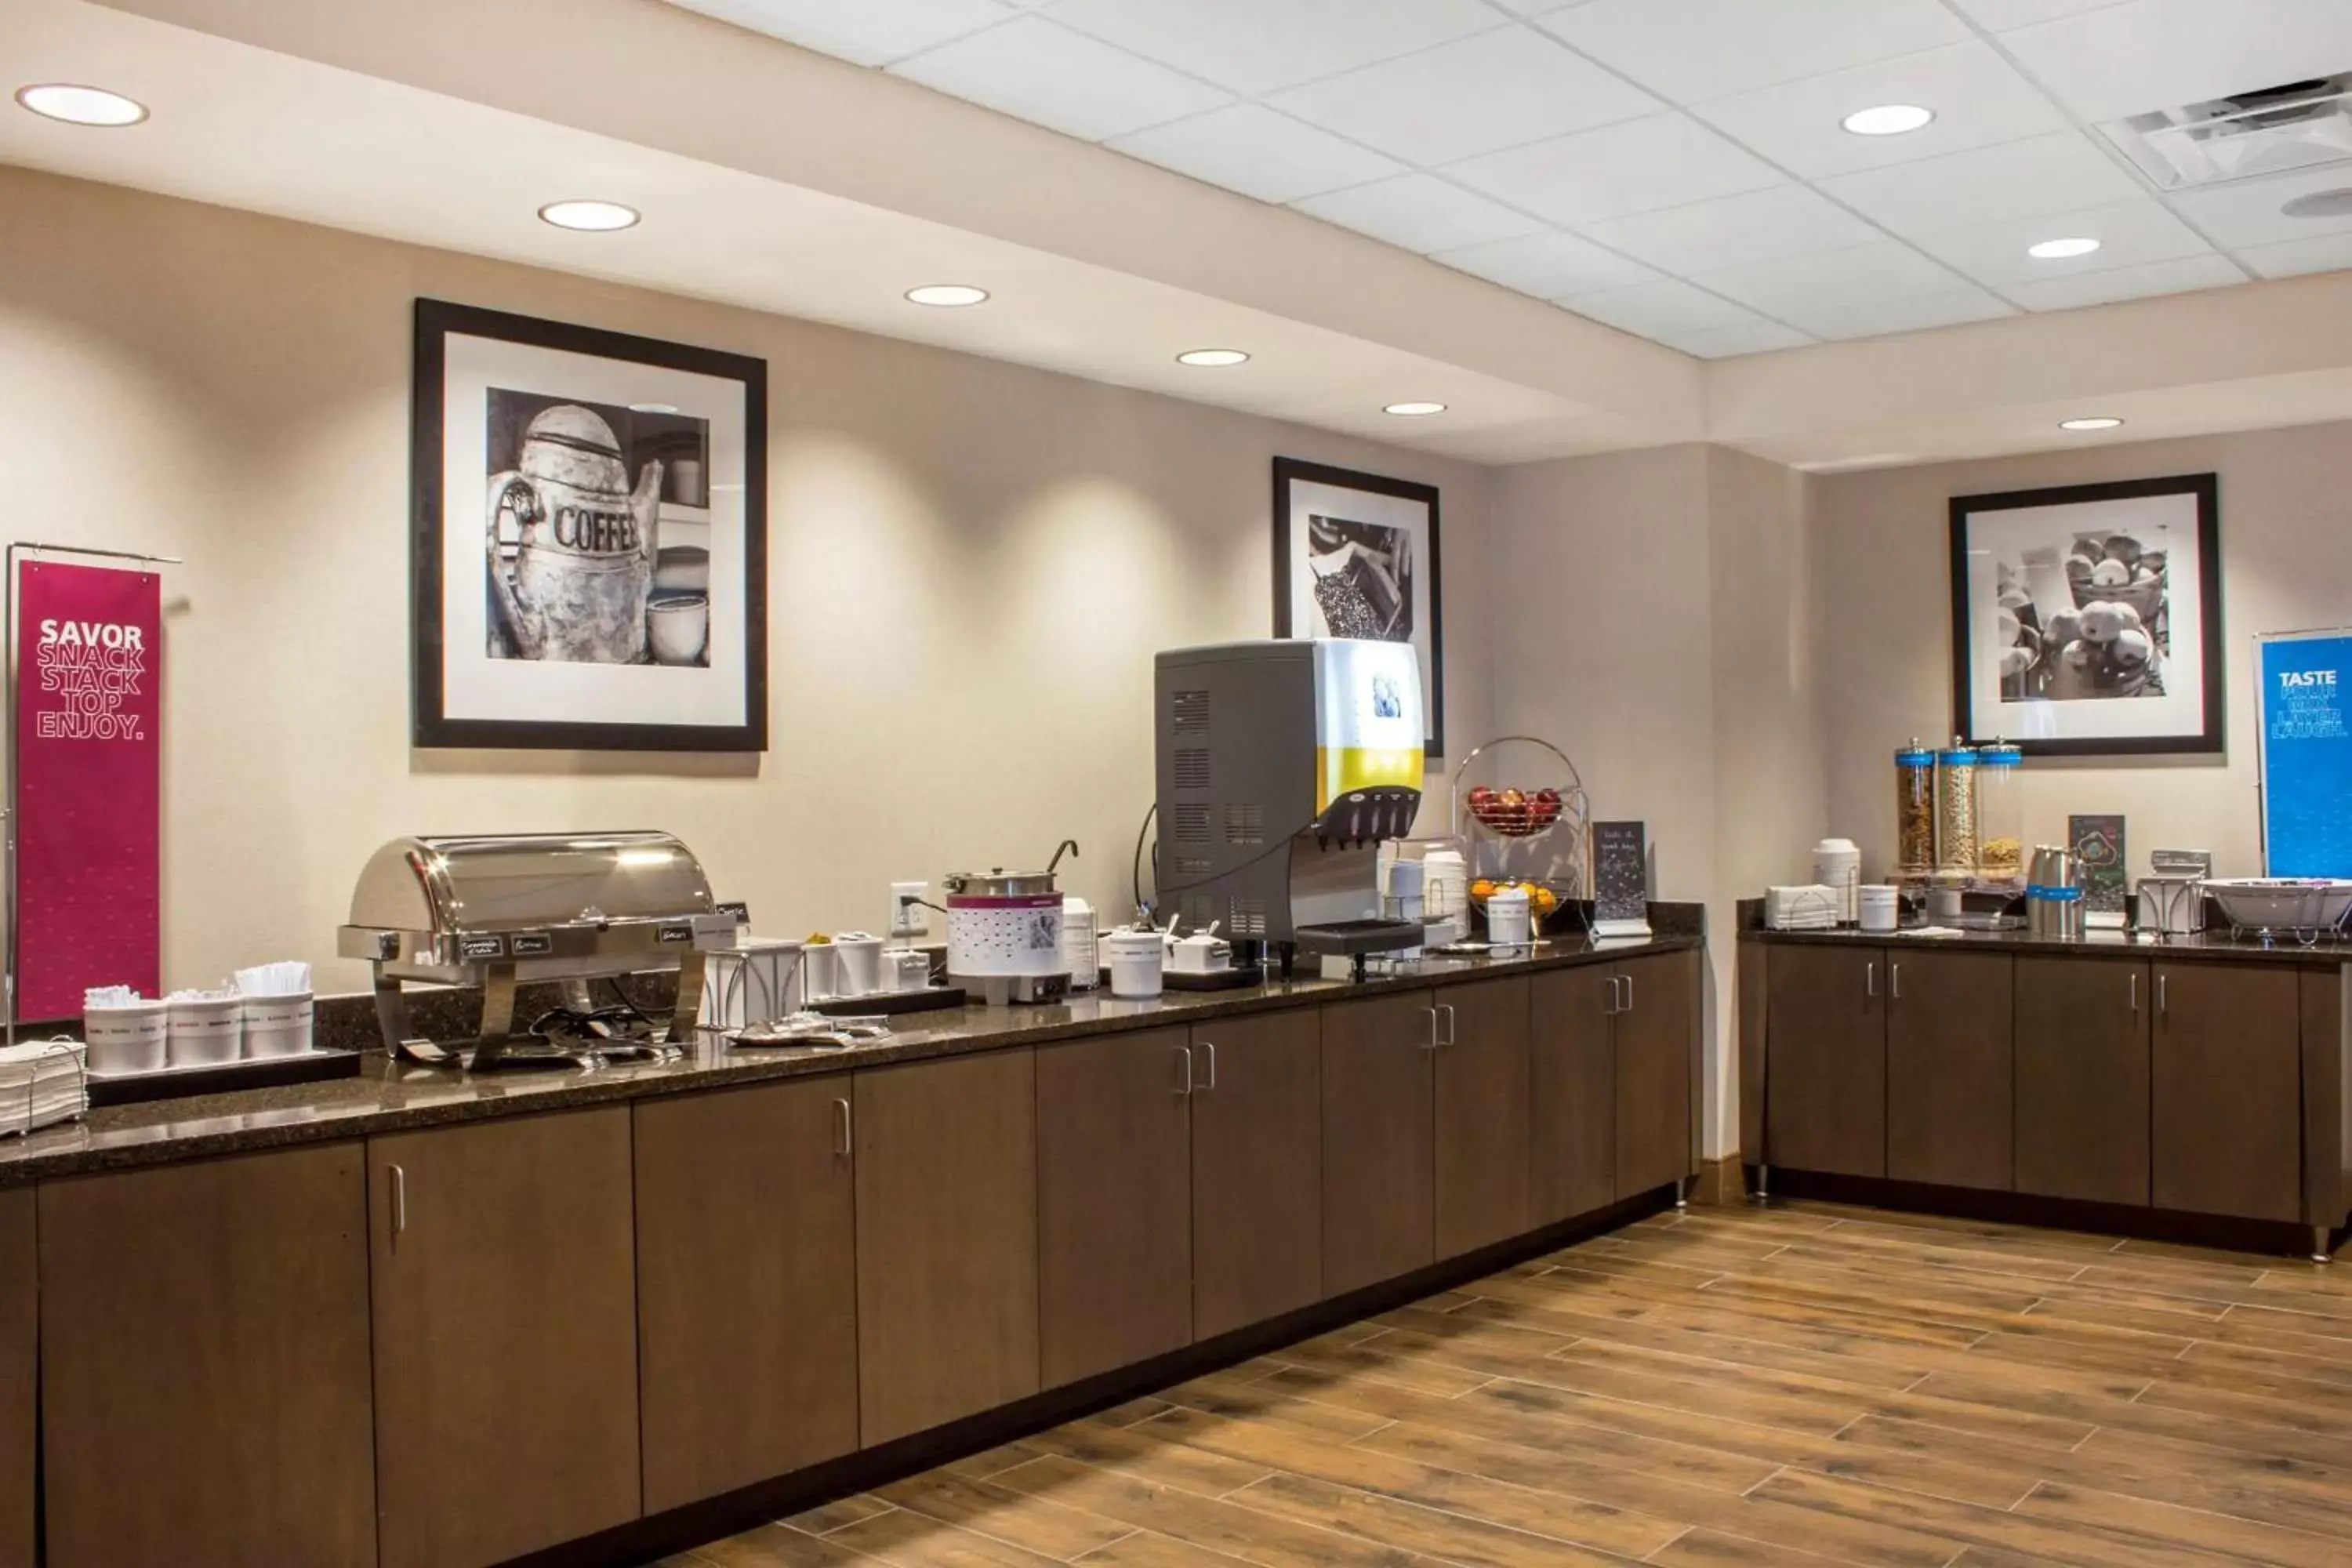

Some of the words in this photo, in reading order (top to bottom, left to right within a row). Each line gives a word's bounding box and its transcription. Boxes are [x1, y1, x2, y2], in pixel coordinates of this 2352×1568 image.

[40, 619, 143, 649] SAVOR
[37, 642, 145, 672] SNACK
[42, 664, 141, 695] STACK
[2278, 670, 2337, 687] TASTE
[61, 689, 122, 715] TOP
[37, 711, 144, 740] ENJOY.
